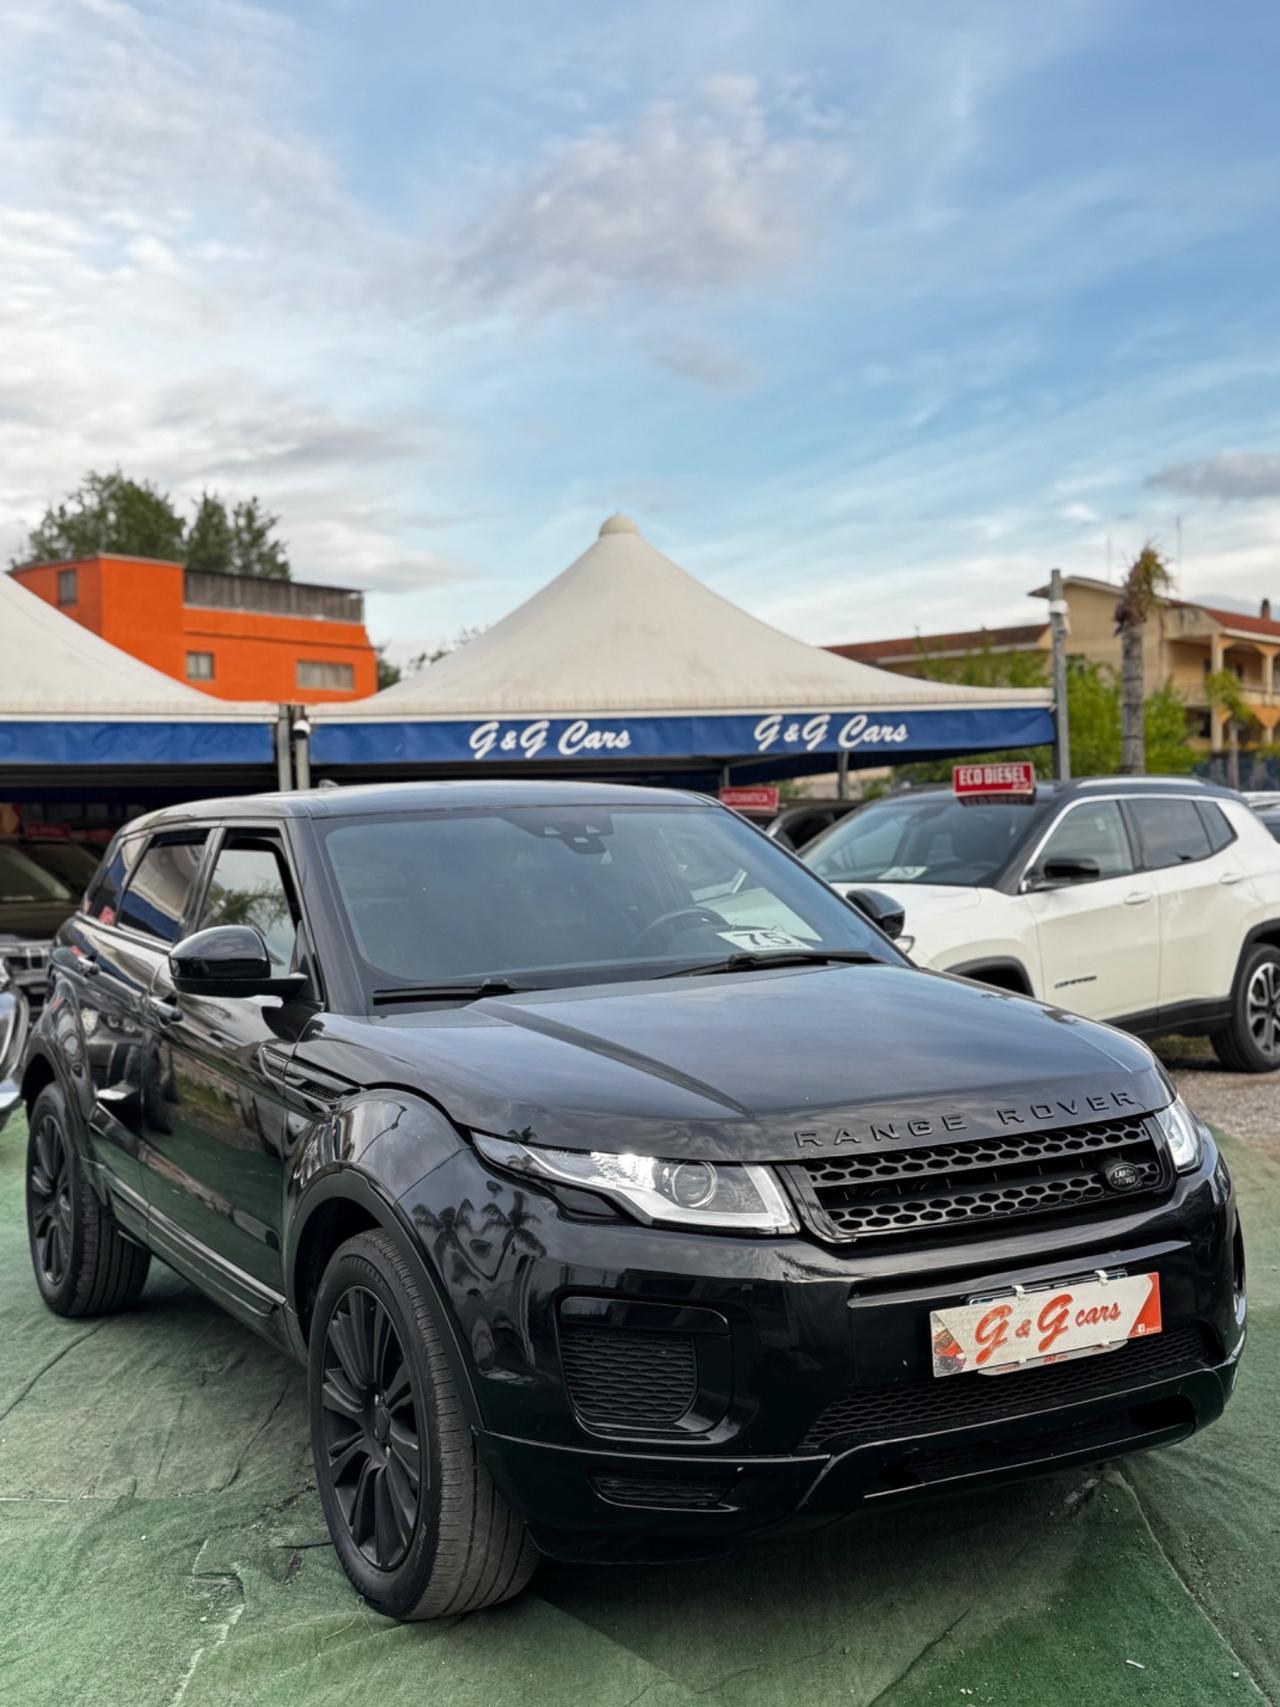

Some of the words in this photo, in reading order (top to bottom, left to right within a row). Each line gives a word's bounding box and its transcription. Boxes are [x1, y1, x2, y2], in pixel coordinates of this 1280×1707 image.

[558, 720, 631, 756] Cars
[838, 714, 909, 748] Cars
[959, 769, 982, 786] ECO
[984, 765, 1026, 785] DIESEL
[794, 1113, 967, 1148] RANGE
[996, 1092, 1135, 1125] ROVER
[1074, 1302, 1121, 1327] cars
